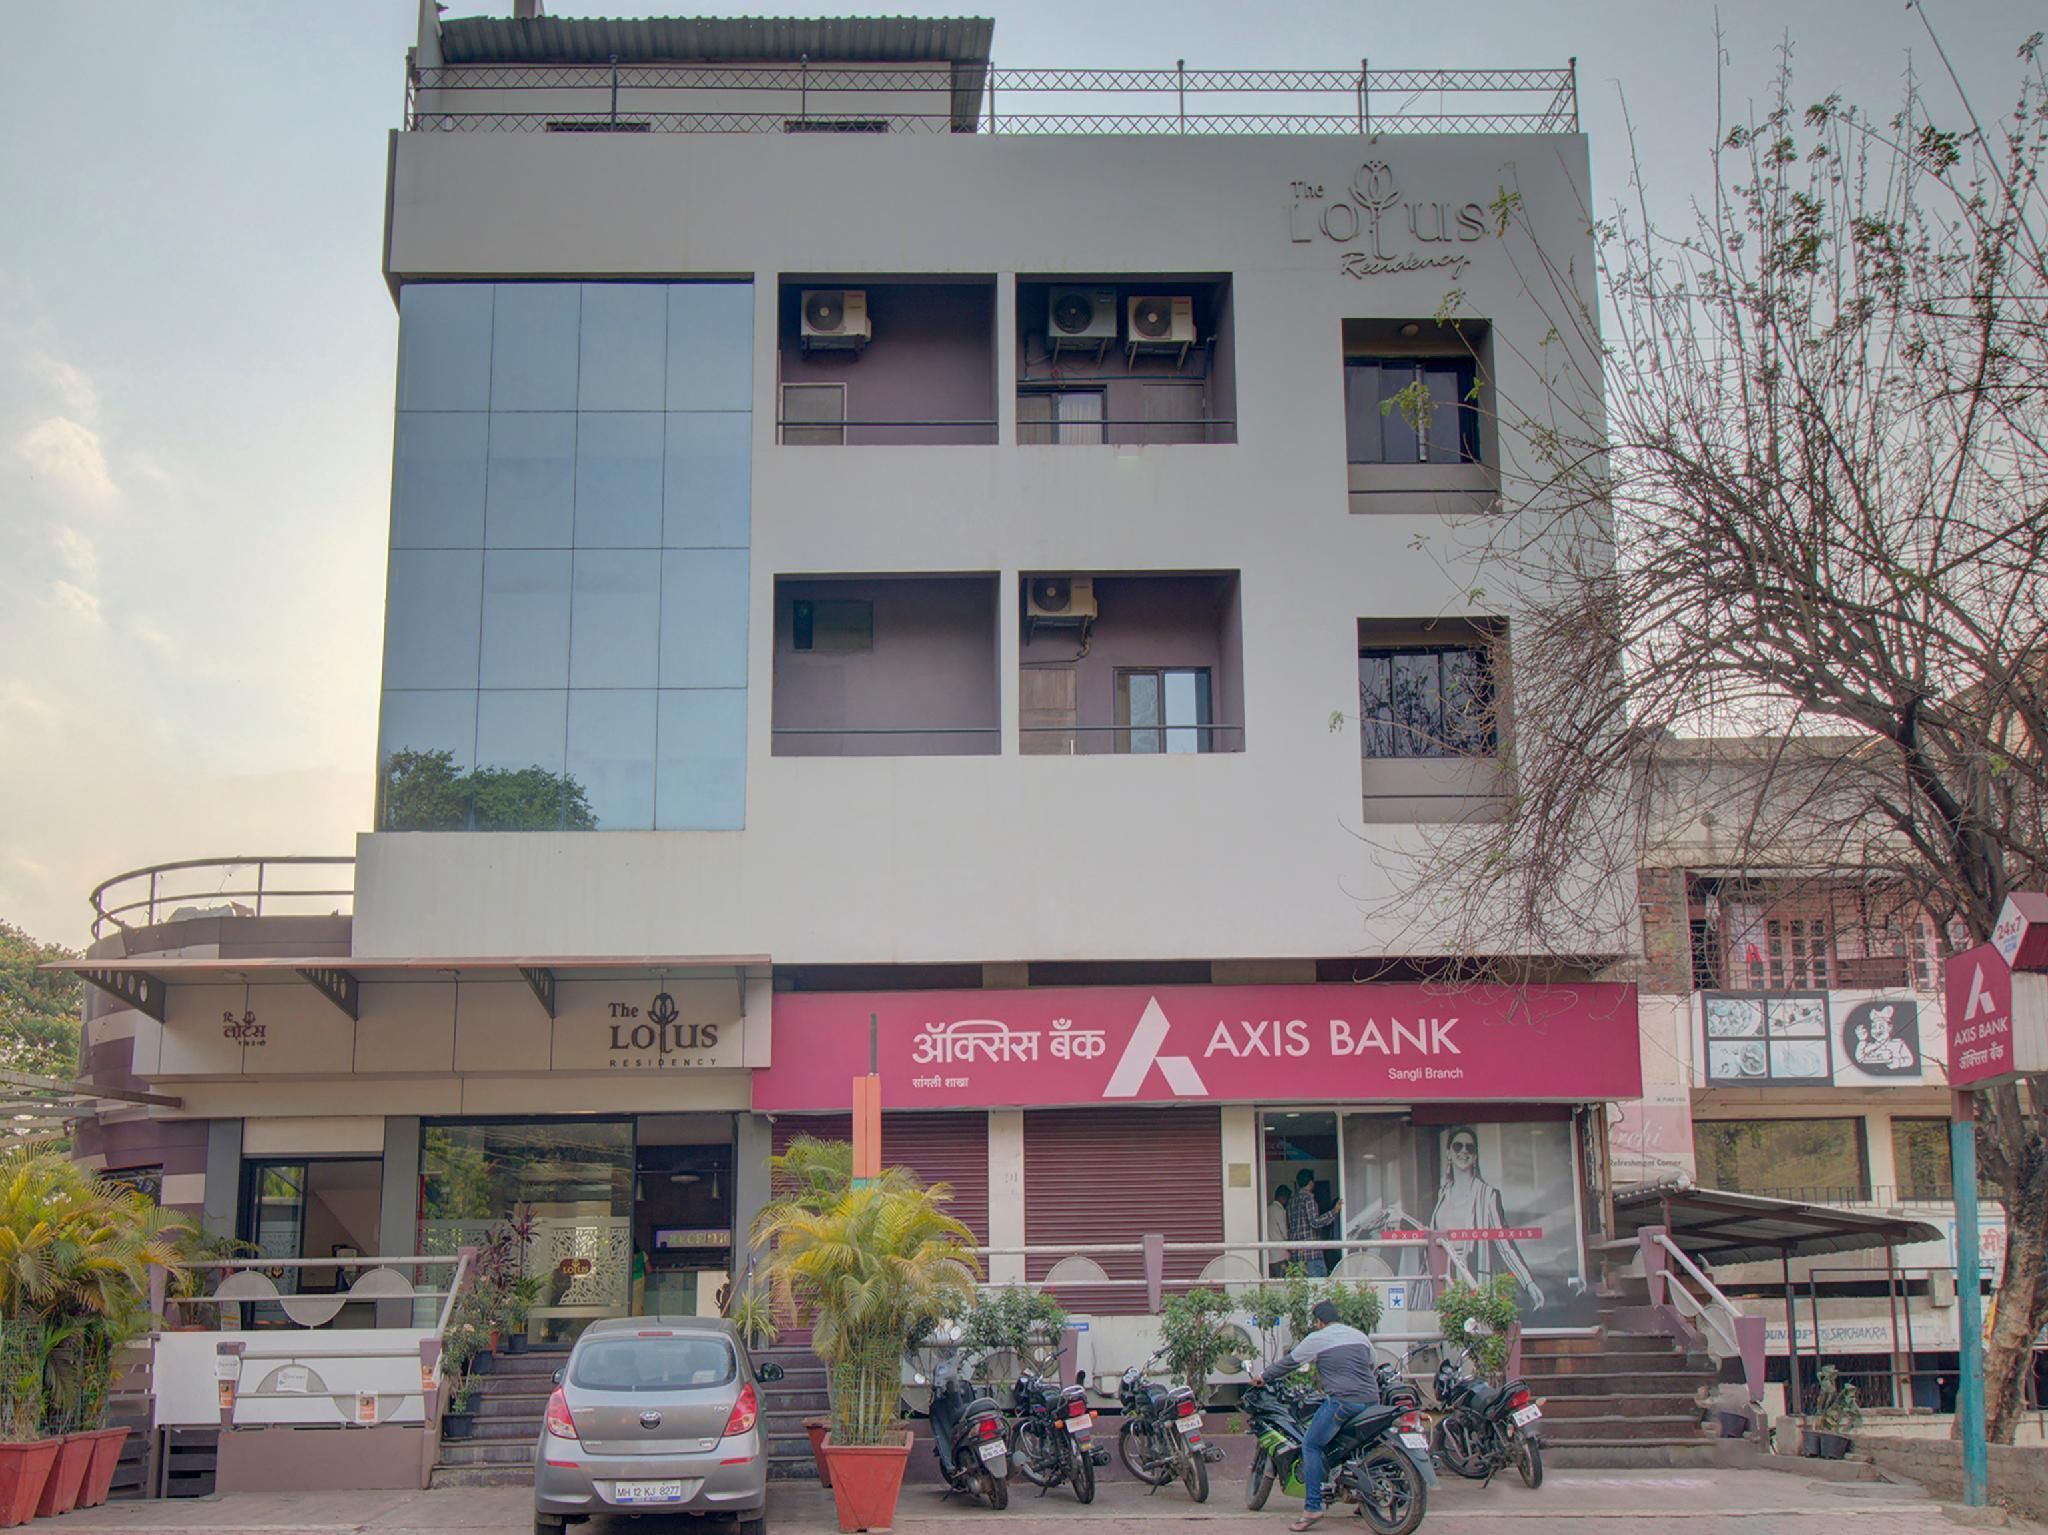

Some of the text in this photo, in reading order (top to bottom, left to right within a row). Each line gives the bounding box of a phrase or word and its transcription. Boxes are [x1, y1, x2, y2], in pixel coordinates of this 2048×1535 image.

[1290, 181, 1324, 198] The
[1340, 251, 1471, 280] Residency
[608, 1002, 639, 1018] The
[1203, 1016, 1462, 1057] AXIS BANK
[1953, 1015, 2008, 1046] AXIS BANK
[609, 1058, 717, 1068] RESIDENCY
[911, 1075, 970, 1088] सांगली शाखा
[1387, 1067, 1464, 1082] Sangli Branch
[1498, 1230, 1534, 1238] axis
[617, 1485, 680, 1497] MH 12 KJ 8277
